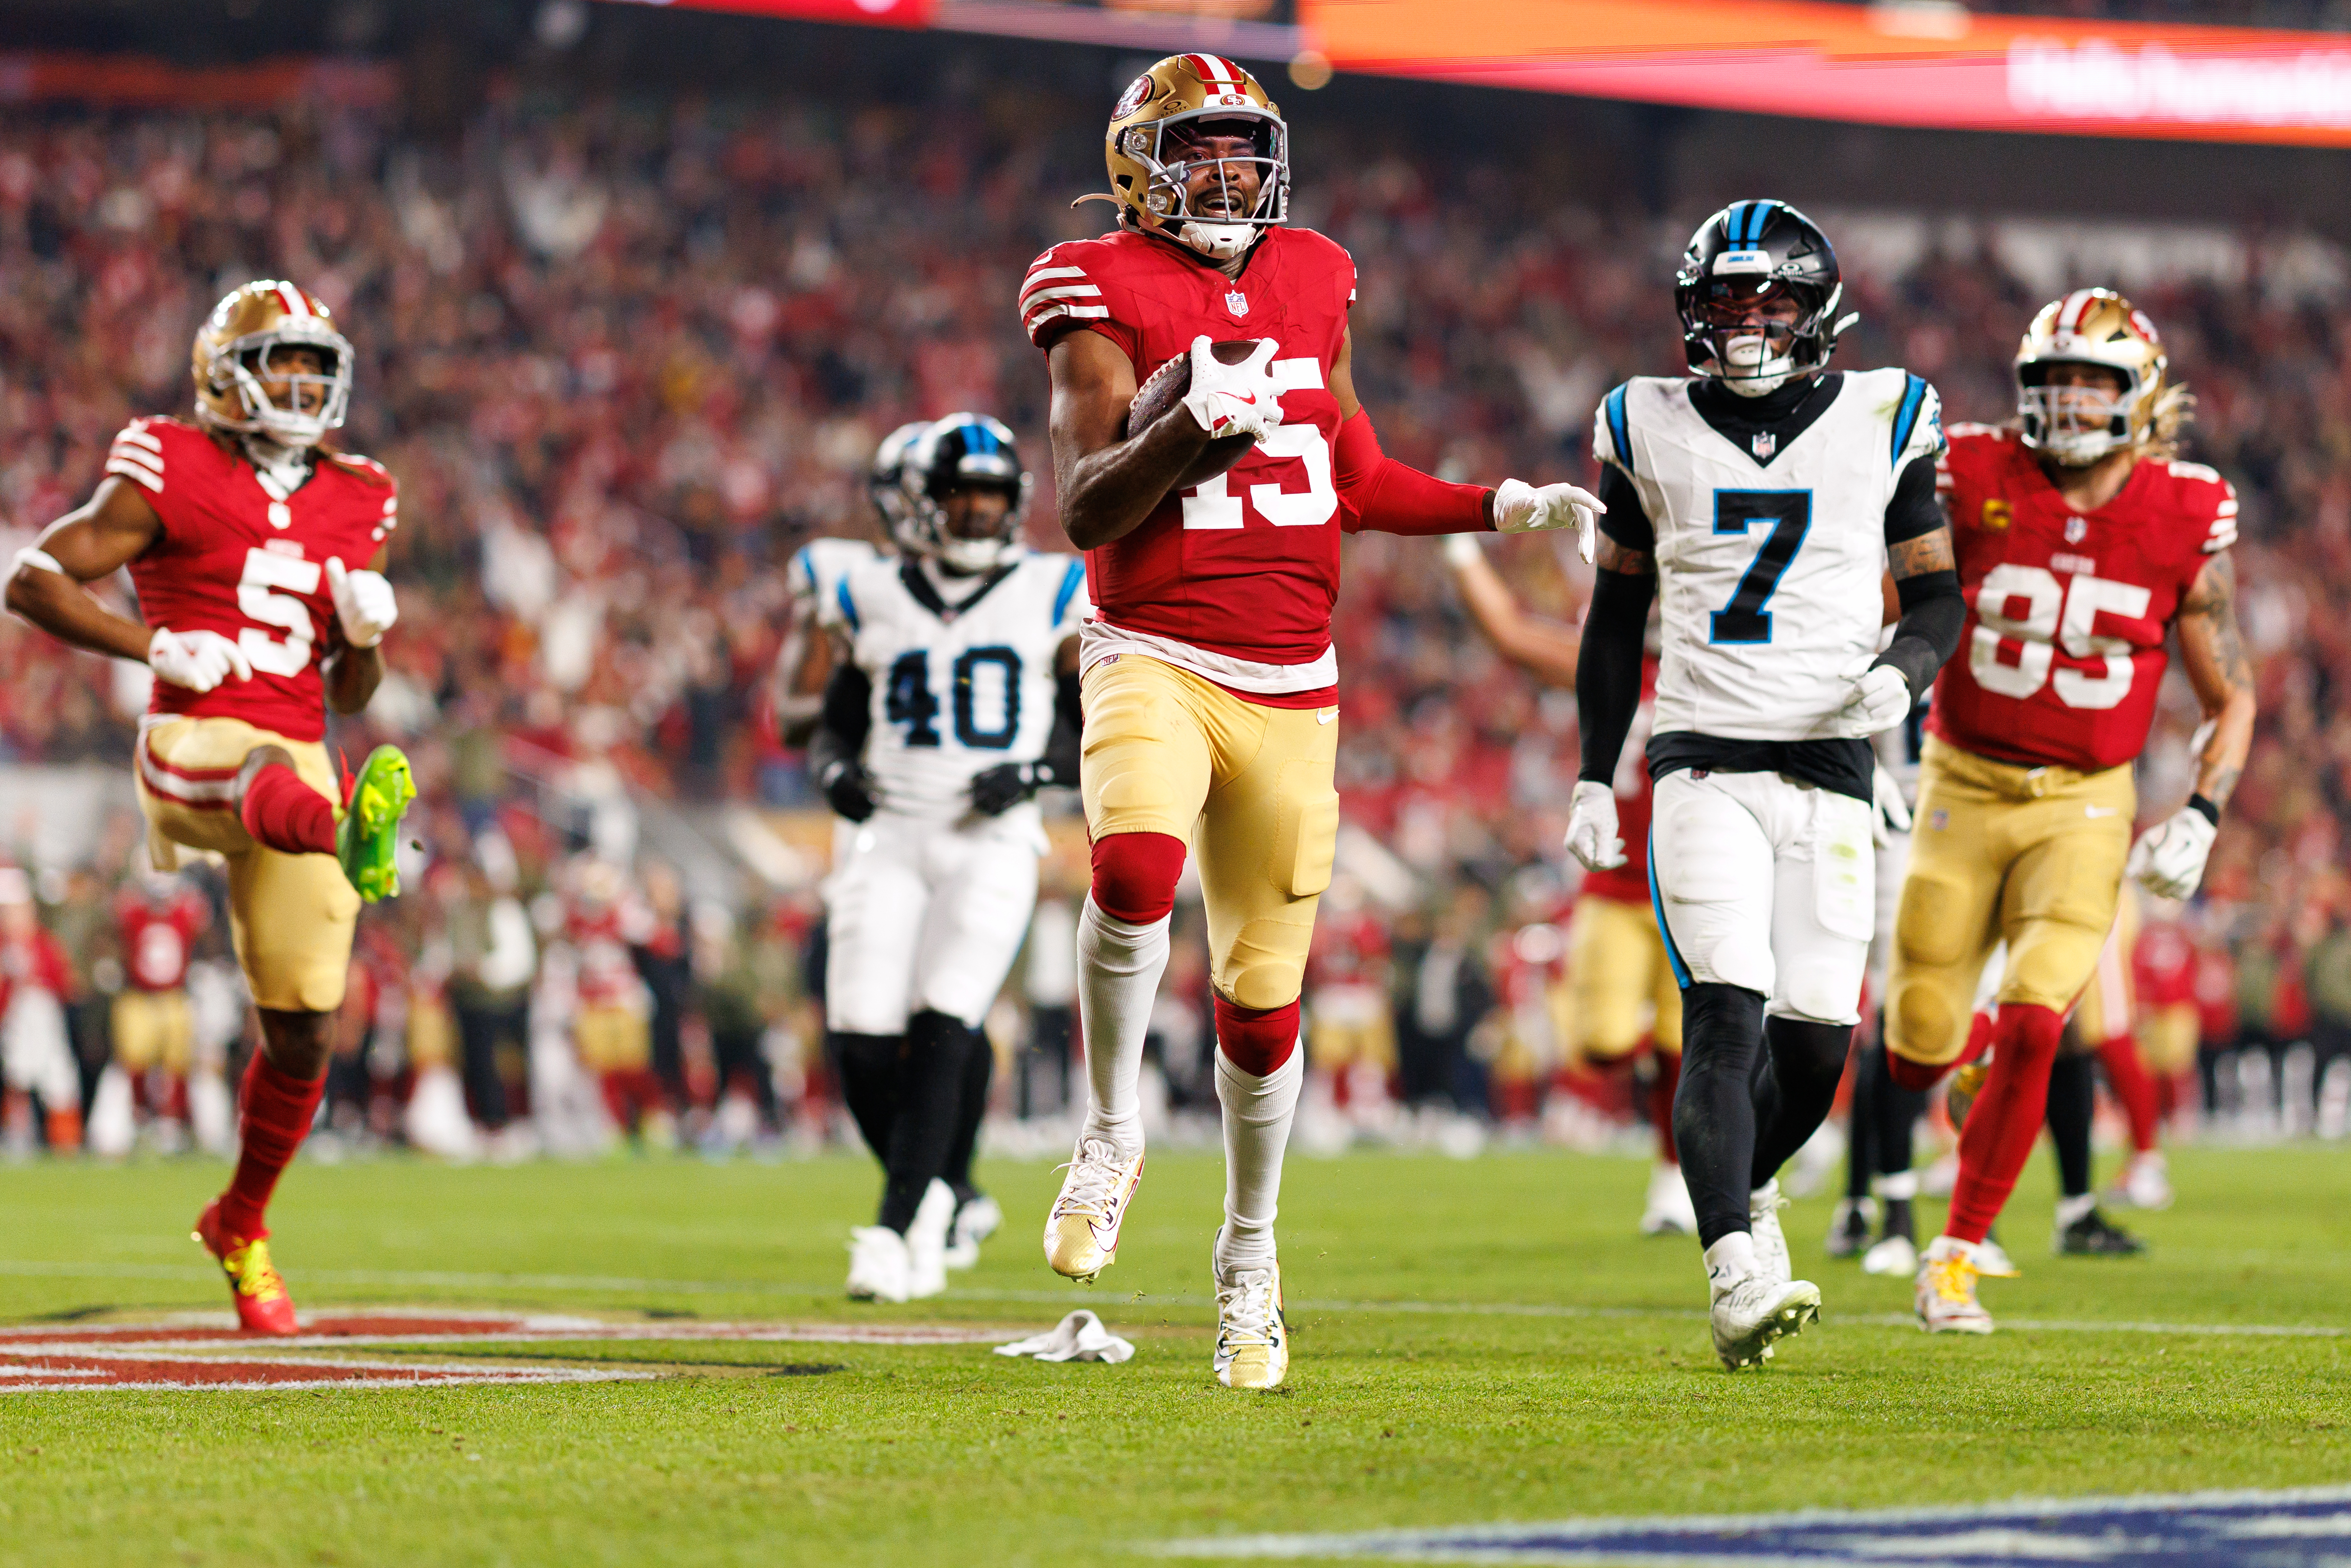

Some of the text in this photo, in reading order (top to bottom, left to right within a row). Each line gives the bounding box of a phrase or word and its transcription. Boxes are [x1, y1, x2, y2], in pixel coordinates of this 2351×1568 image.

[1230, 302, 1245, 312] NFL
[237, 547, 322, 677] 5
[1709, 488, 1813, 645] 7
[886, 645, 1023, 748] 40
[1969, 563, 2152, 709] 85
